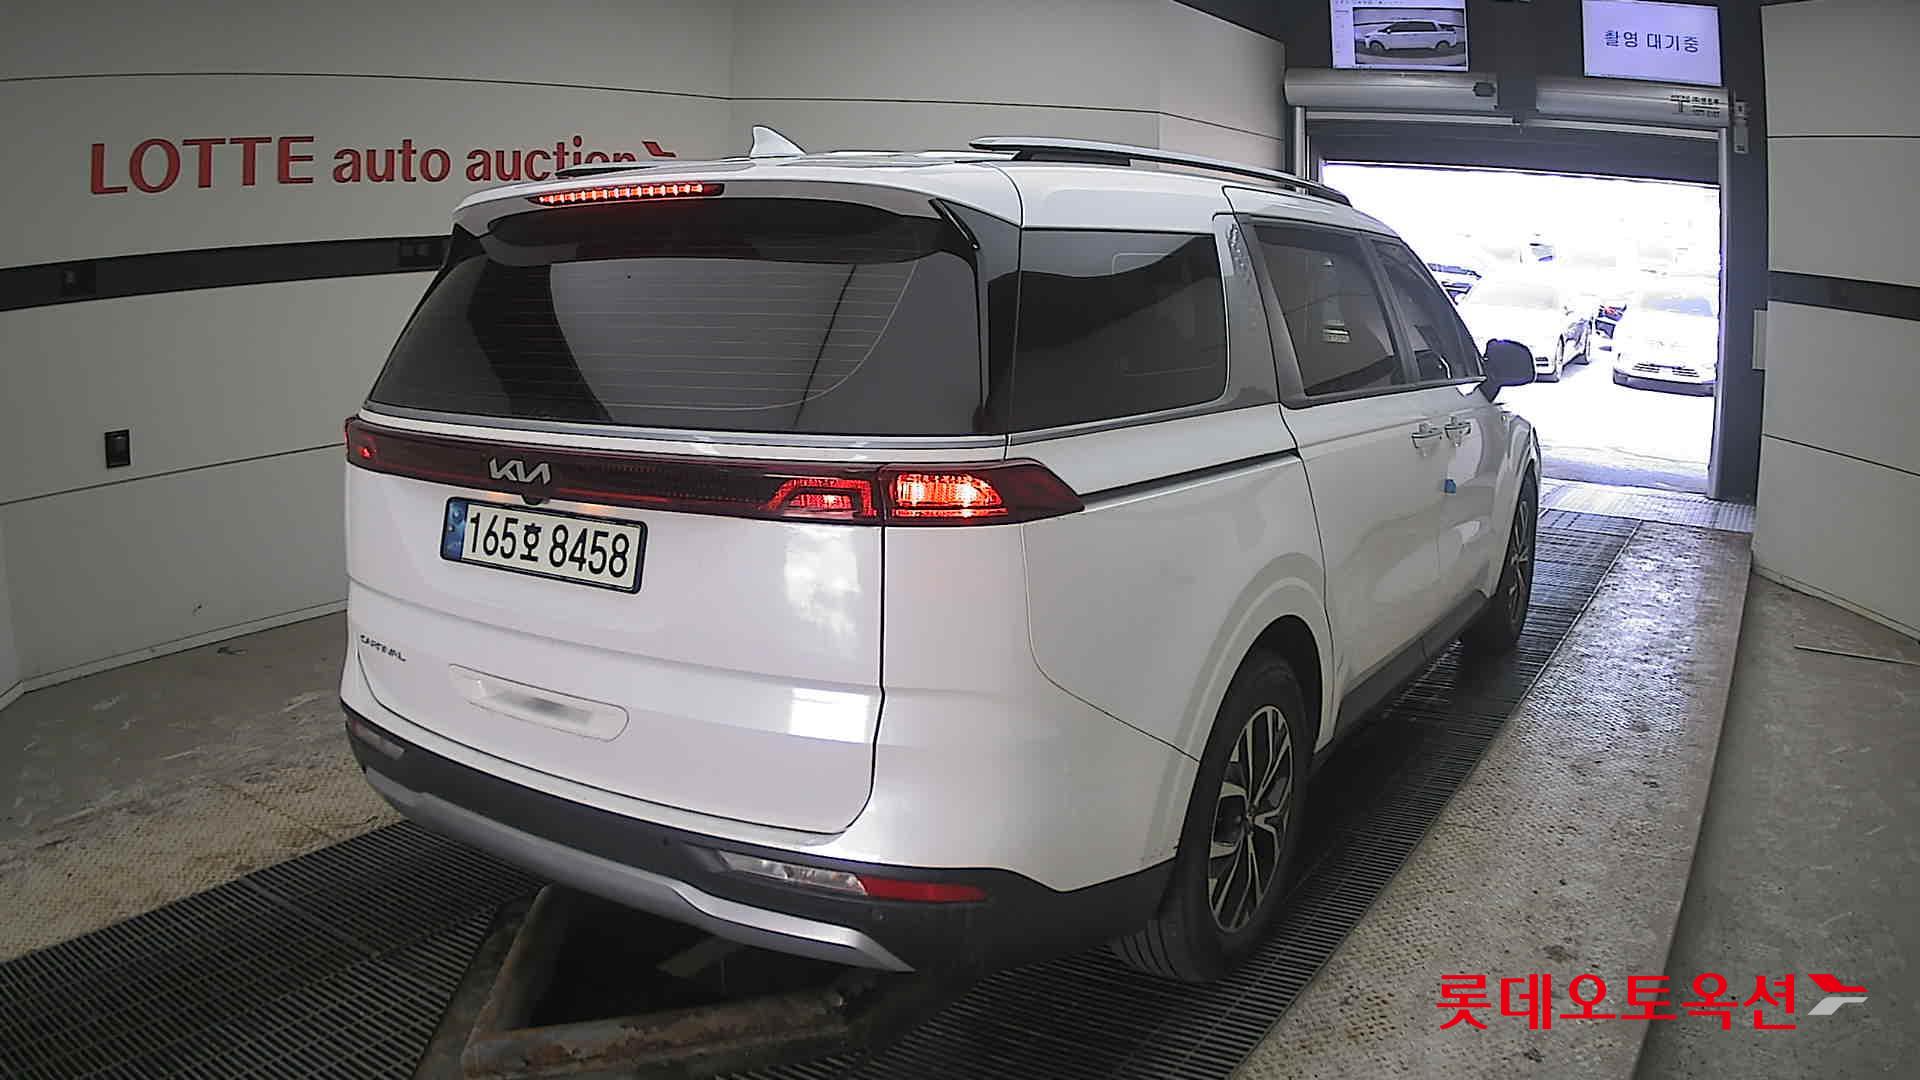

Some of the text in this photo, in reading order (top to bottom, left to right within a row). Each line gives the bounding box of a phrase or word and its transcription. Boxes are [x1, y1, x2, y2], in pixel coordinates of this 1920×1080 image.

[1605, 31, 1699, 53] 촬영 대기중
[91, 135, 315, 196] LOTTE
[332, 138, 451, 183] auto
[488, 456, 552, 485] KIA
[469, 511, 630, 578] 165호 8458
